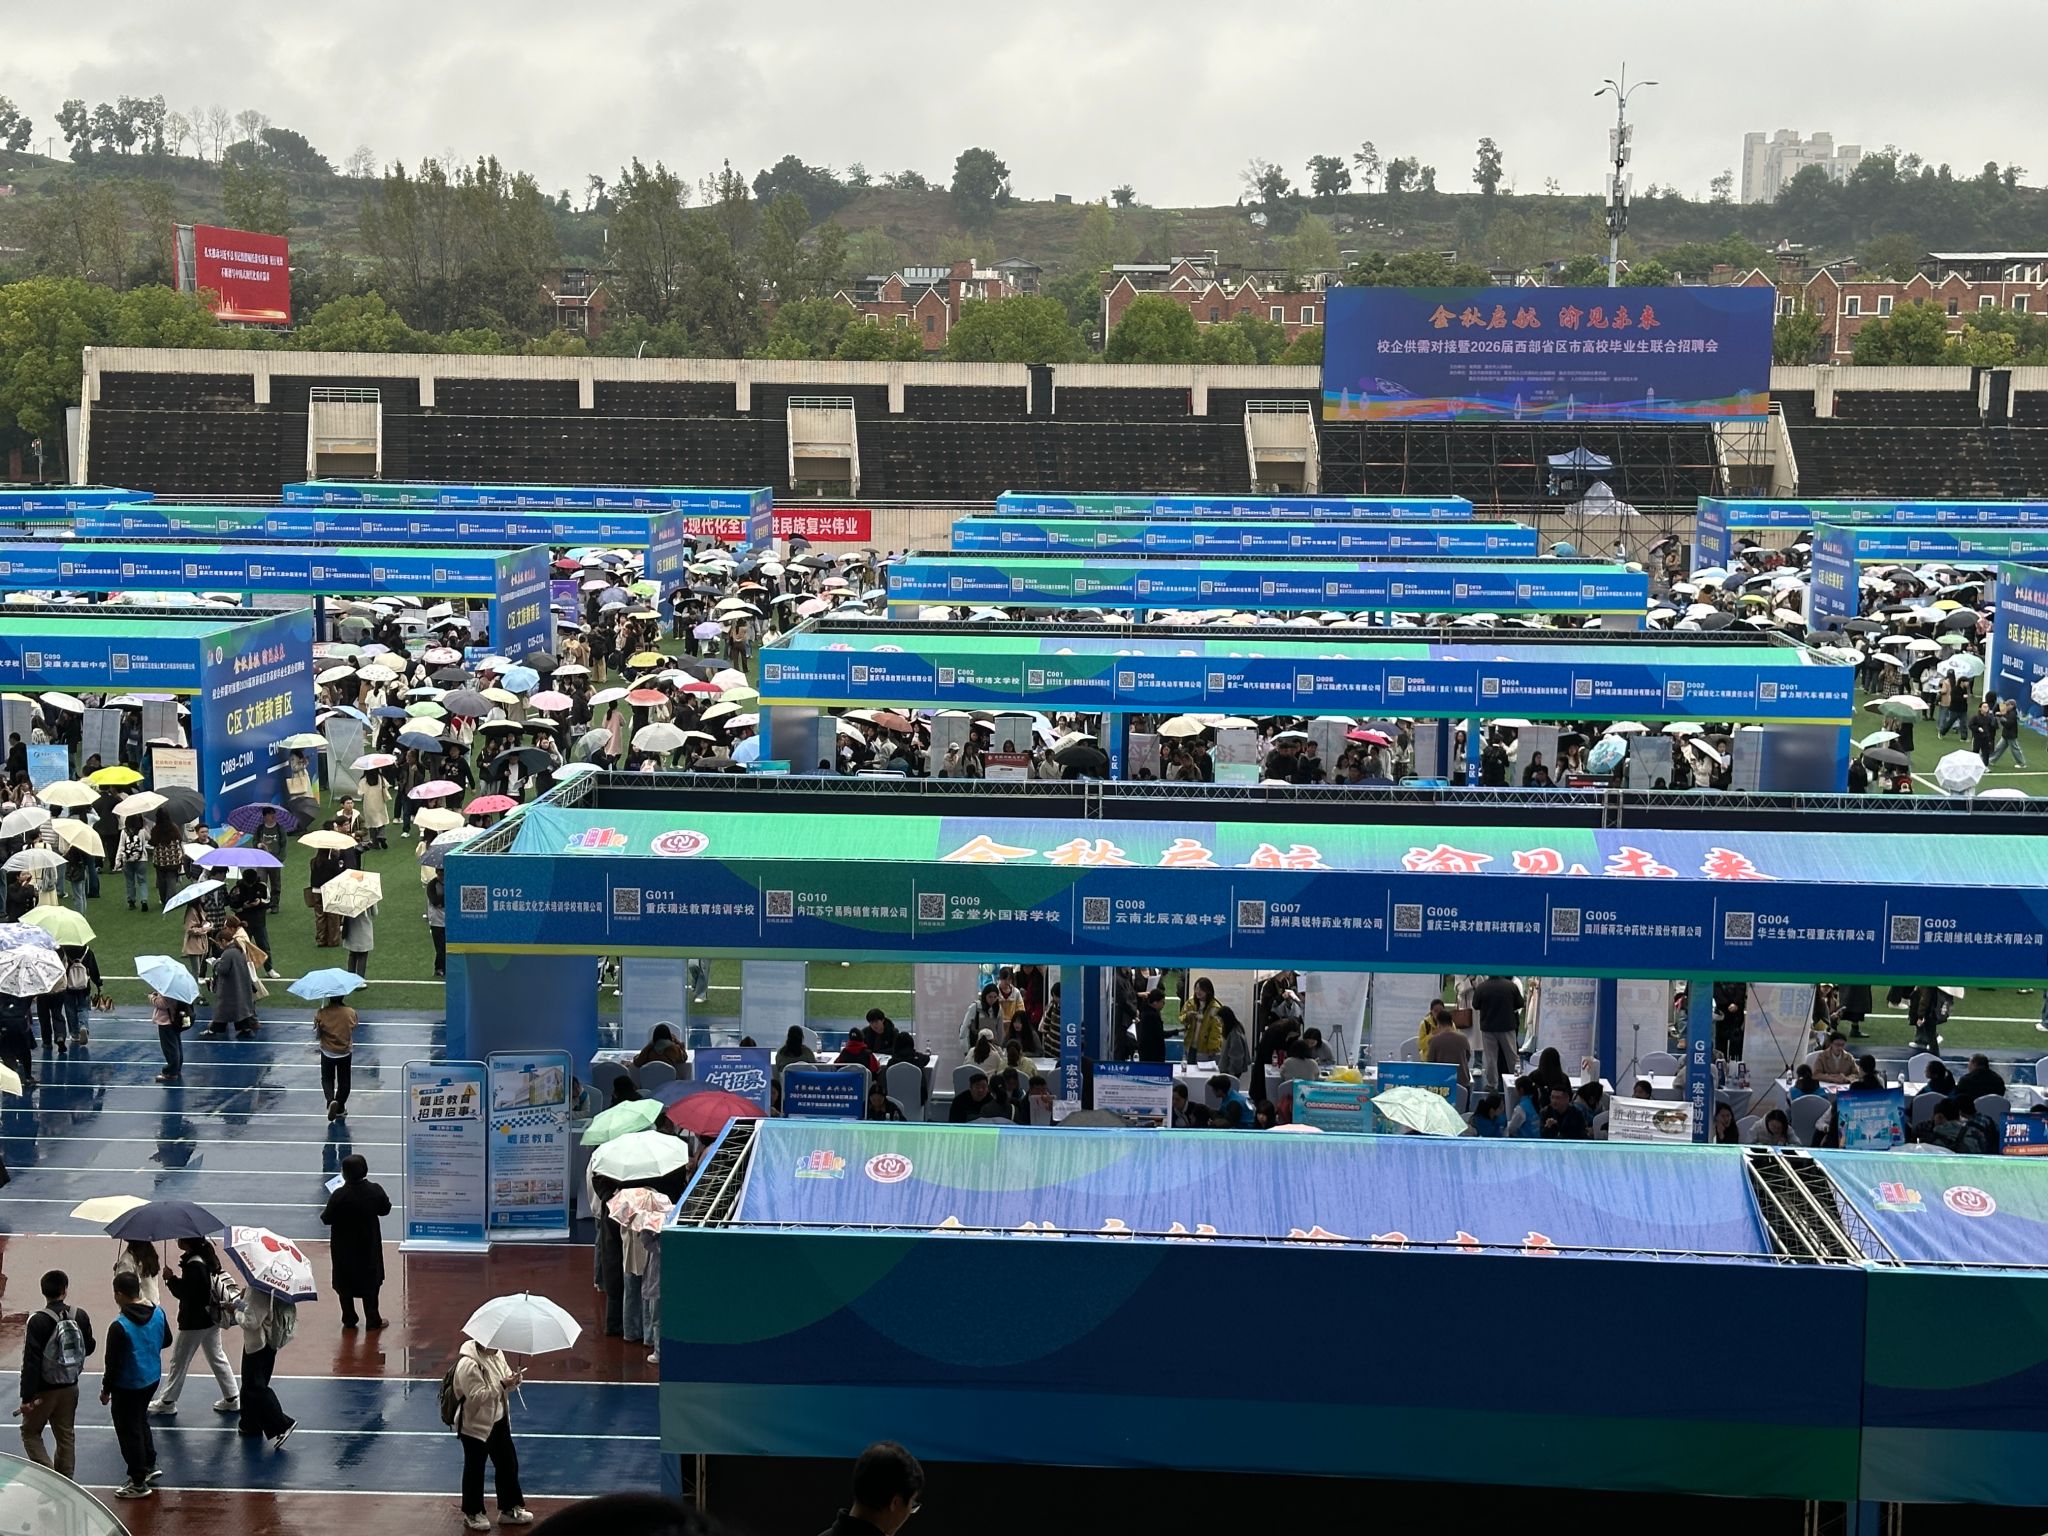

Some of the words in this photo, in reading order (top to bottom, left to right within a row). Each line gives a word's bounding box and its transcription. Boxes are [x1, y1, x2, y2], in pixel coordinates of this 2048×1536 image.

[1428, 304, 1541, 330] 金秋启航
[1558, 304, 1661, 330] 渝见未来
[1377, 339, 1719, 354] 校企供需对接暨2026届西部省区市高校毕业生联合招聘会
[2008, 622, 2019, 642] B区
[2020, 624, 2048, 653] 乡村振兴
[43, 660, 108, 669] 安康市高新中学
[869, 666, 887, 674] C003
[957, 668, 975, 676] C002
[227, 707, 243, 735] C区
[221, 751, 254, 776] C089-C100
[492, 888, 522, 898] G012
[645, 890, 675, 900] G011
[797, 892, 828, 903] G010
[950, 895, 980, 906] G009
[1115, 899, 1146, 910] G008
[645, 902, 755, 916] 重庆瑞达教育培训学校
[797, 904, 908, 918] 内江苏宁易购销售有限公司
[1270, 903, 1301, 913] G007
[1426, 906, 1458, 917] G006
[950, 908, 1060, 922] 金堂外国语学校
[1115, 912, 1227, 926] 云南北辰高级中学
[1585, 910, 1617, 921] G005
[1757, 914, 1790, 925] G004
[1270, 915, 1383, 930] 扬州奥锐特药业有限公司
[1426, 919, 1541, 934] 重庆三中英才教育科技有限公司
[1924, 918, 1957, 929] G003
[1584, 923, 1702, 938] 四川新荷花中药饮片股份有限公司
[1757, 927, 1875, 942] 华兰生物工程重庆有限公司
[1924, 931, 2044, 946] 重庆朗维机电技术有限公司
[418, 1106, 471, 1119] 招聘启事
